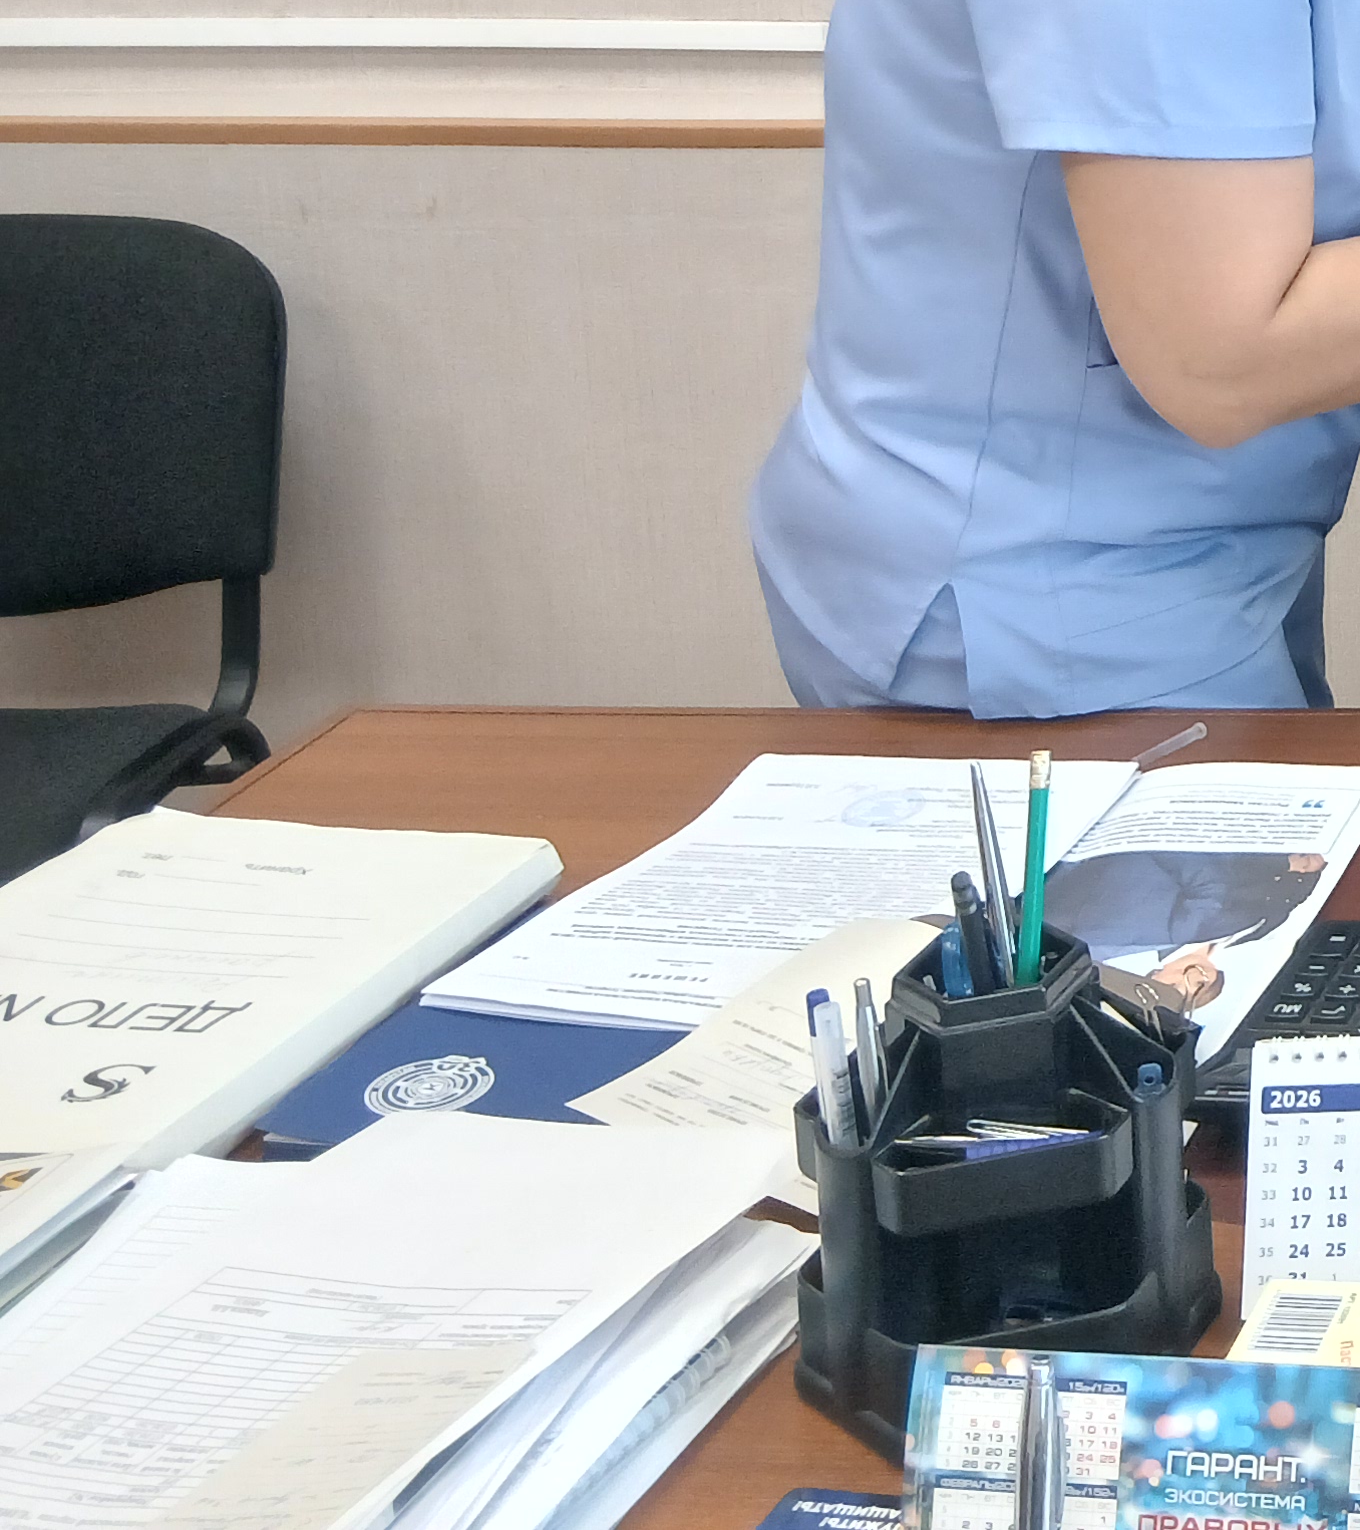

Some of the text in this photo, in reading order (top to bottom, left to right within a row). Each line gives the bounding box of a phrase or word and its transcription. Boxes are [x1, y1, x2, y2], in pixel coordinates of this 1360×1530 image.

[45, 999, 253, 1033] ДЕЛО
[1269, 1090, 1321, 1108] 2026
[1298, 1160, 1308, 1174] 3
[1333, 1159, 1344, 1172] 4
[1292, 1187, 1312, 1201] 10
[1329, 1186, 1348, 1200] 11
[1290, 1215, 1310, 1229] 17
[1327, 1214, 1347, 1227] 18
[1289, 1245, 1309, 1258] 24
[1325, 1243, 1346, 1257] 25
[1165, 1449, 1306, 1484] ГАРАНТ.
[1164, 1488, 1306, 1511] ЭКОСИСТЕМА
[791, 1500, 904, 1519] АЩИЩАТЬ!
